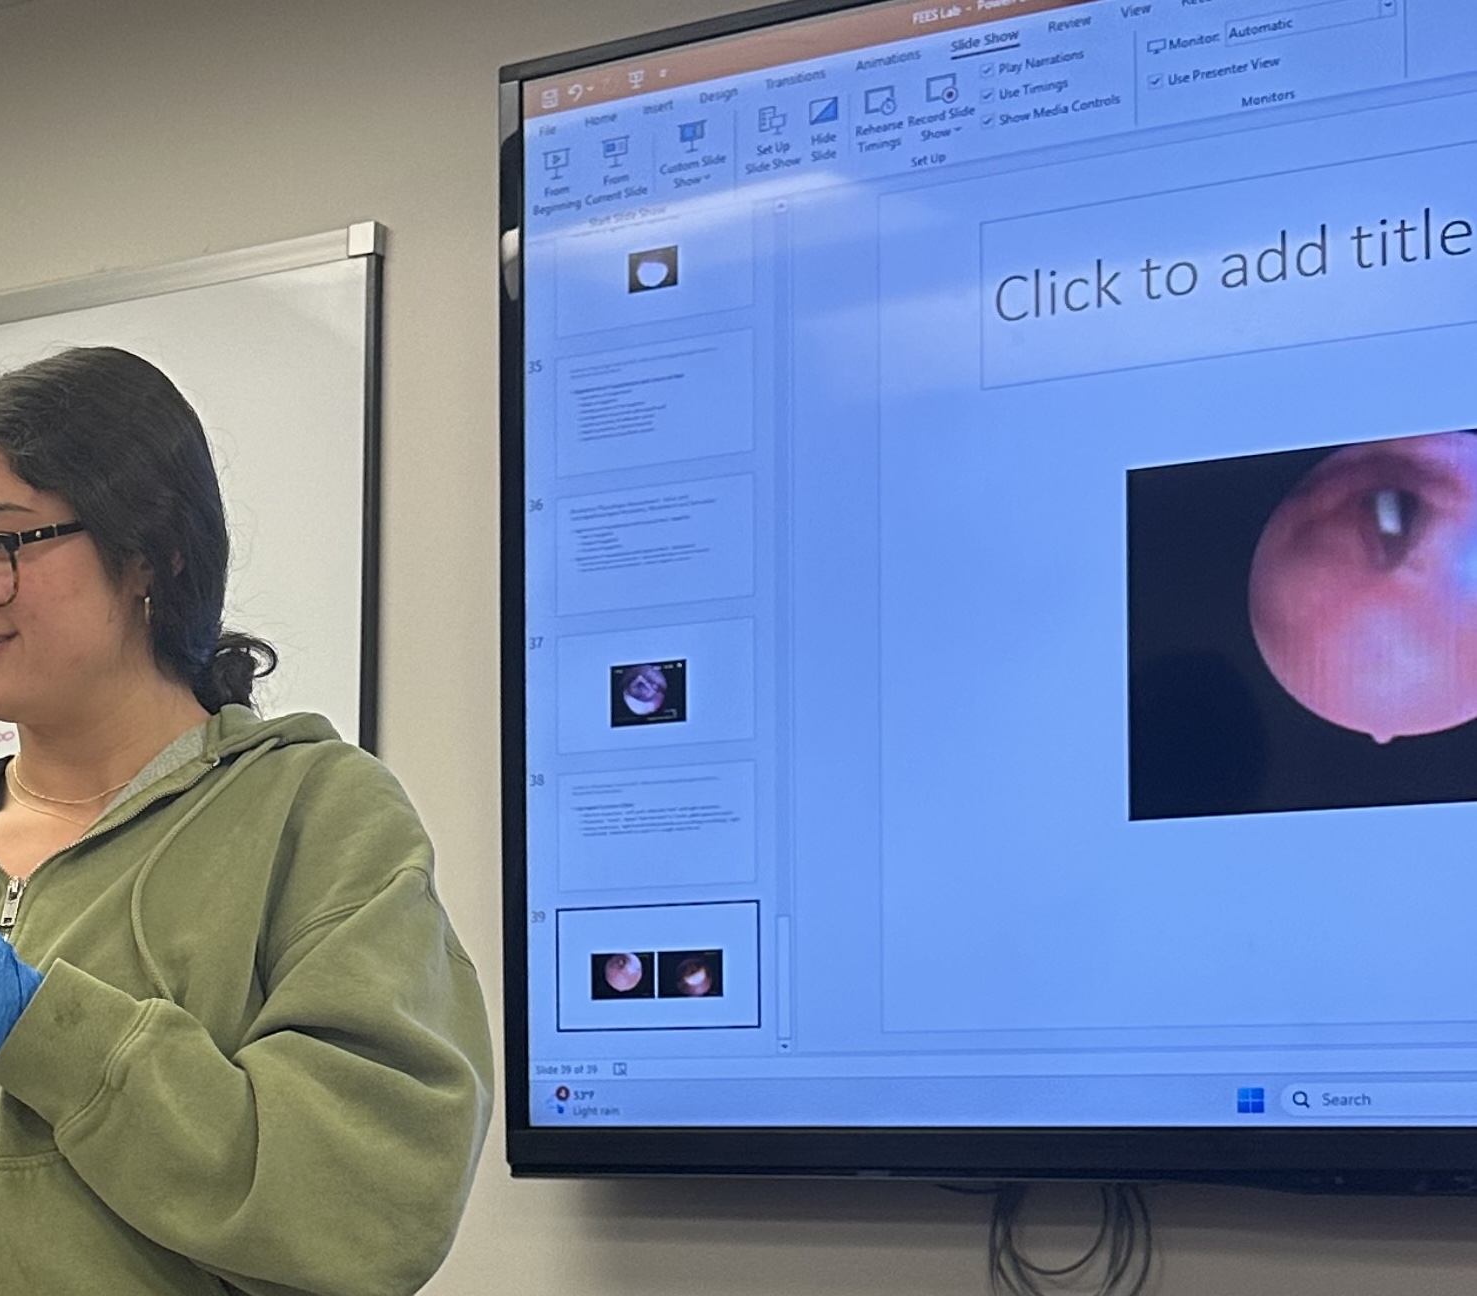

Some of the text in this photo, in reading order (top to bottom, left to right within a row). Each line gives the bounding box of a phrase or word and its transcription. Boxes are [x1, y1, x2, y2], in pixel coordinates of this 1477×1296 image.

[912, 9, 939, 25] FEES
[940, 5, 962, 20] Lab
[1121, 3, 1152, 19] View
[1048, 15, 1093, 33] Review
[1228, 18, 1293, 40] Automatic
[951, 30, 1020, 53] Slide Show
[855, 49, 922, 71] Animations
[998, 50, 1085, 76] Play Narrations
[765, 68, 826, 90] Transitions
[1168, 56, 1282, 87] Use Presenter View
[699, 87, 739, 104] Design
[999, 79, 1069, 101] Use Timings
[1240, 88, 1296, 109] Monitors
[642, 100, 674, 116] Insert
[907, 105, 976, 128] Record Slide
[999, 93, 1122, 127] Show Media Controls
[584, 112, 618, 127] Home
[538, 125, 557, 137] File
[855, 120, 904, 137] Rehearse
[920, 128, 952, 142] Show
[810, 132, 837, 146] Hide
[857, 136, 902, 154] Timings
[756, 141, 791, 157] Set Up
[810, 149, 837, 163] Slide
[659, 154, 727, 176] Custom Slide
[744, 156, 802, 175] Slide Show
[910, 151, 947, 168] Set Up
[602, 173, 631, 187] From
[673, 176, 702, 189] Show
[543, 185, 570, 198] From
[584, 185, 649, 206] Current Slide
[532, 199, 582, 216] Beginning
[994, 206, 1474, 323] Click to add title
[527, 358, 544, 376] 35
[528, 498, 545, 513] 36
[528, 635, 545, 651] 37
[529, 773, 546, 788] 38
[530, 910, 547, 924] 39
[535, 1062, 599, 1076] Slide 39 of 39
[1320, 1091, 1373, 1108] Search
[572, 1104, 621, 1119] Light rain
